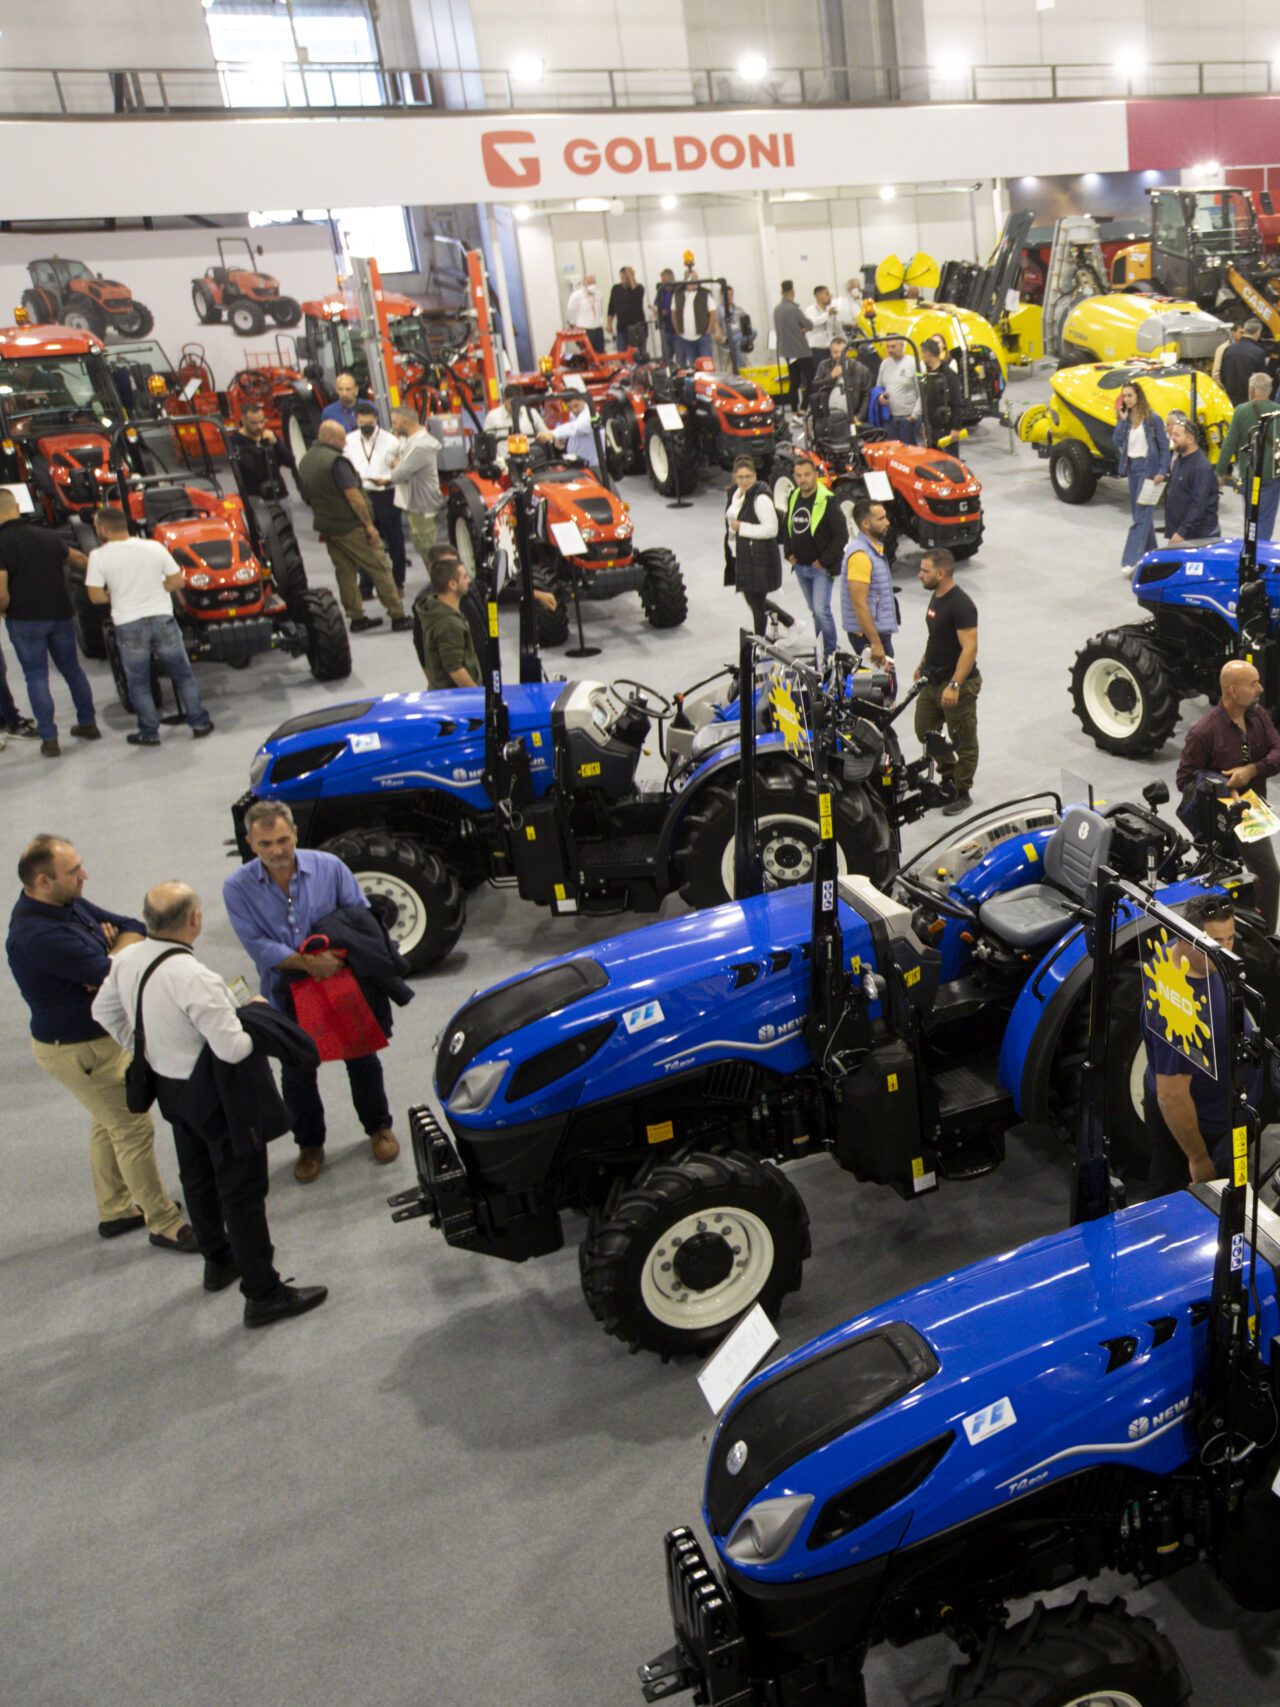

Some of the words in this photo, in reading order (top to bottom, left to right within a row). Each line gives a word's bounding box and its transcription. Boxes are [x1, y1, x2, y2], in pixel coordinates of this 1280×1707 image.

[563, 133, 795, 176] GOLDONI
[1242, 286, 1273, 321] CASE
[1158, 980, 1193, 1017] NEO
[777, 1014, 808, 1036] NEW
[1152, 1397, 1190, 1429] NEW
